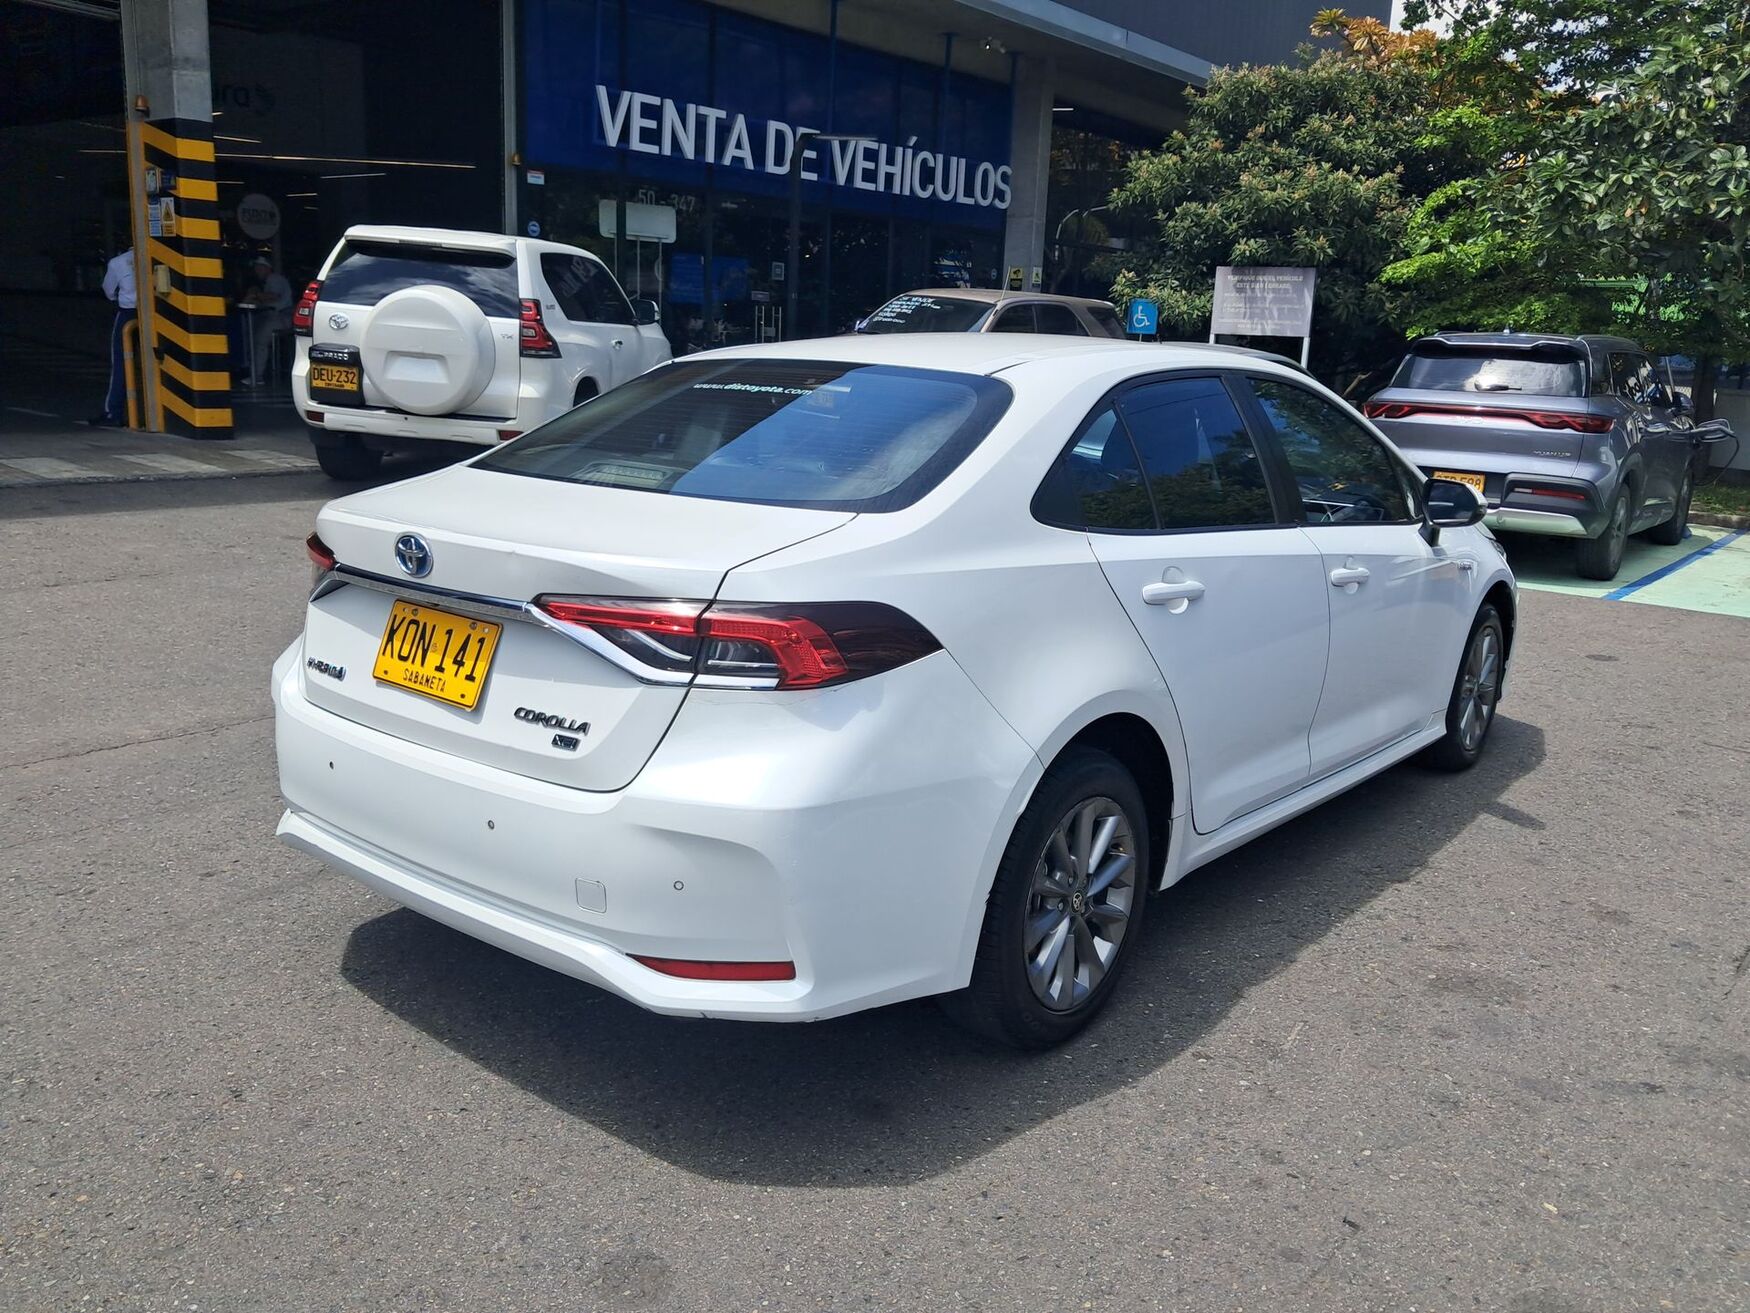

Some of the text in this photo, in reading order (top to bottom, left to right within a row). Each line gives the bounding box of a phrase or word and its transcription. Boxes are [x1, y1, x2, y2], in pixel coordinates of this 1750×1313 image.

[596, 84, 1012, 210] VENTA DE VEHÍCULOS
[514, 706, 591, 736] COROLLA
